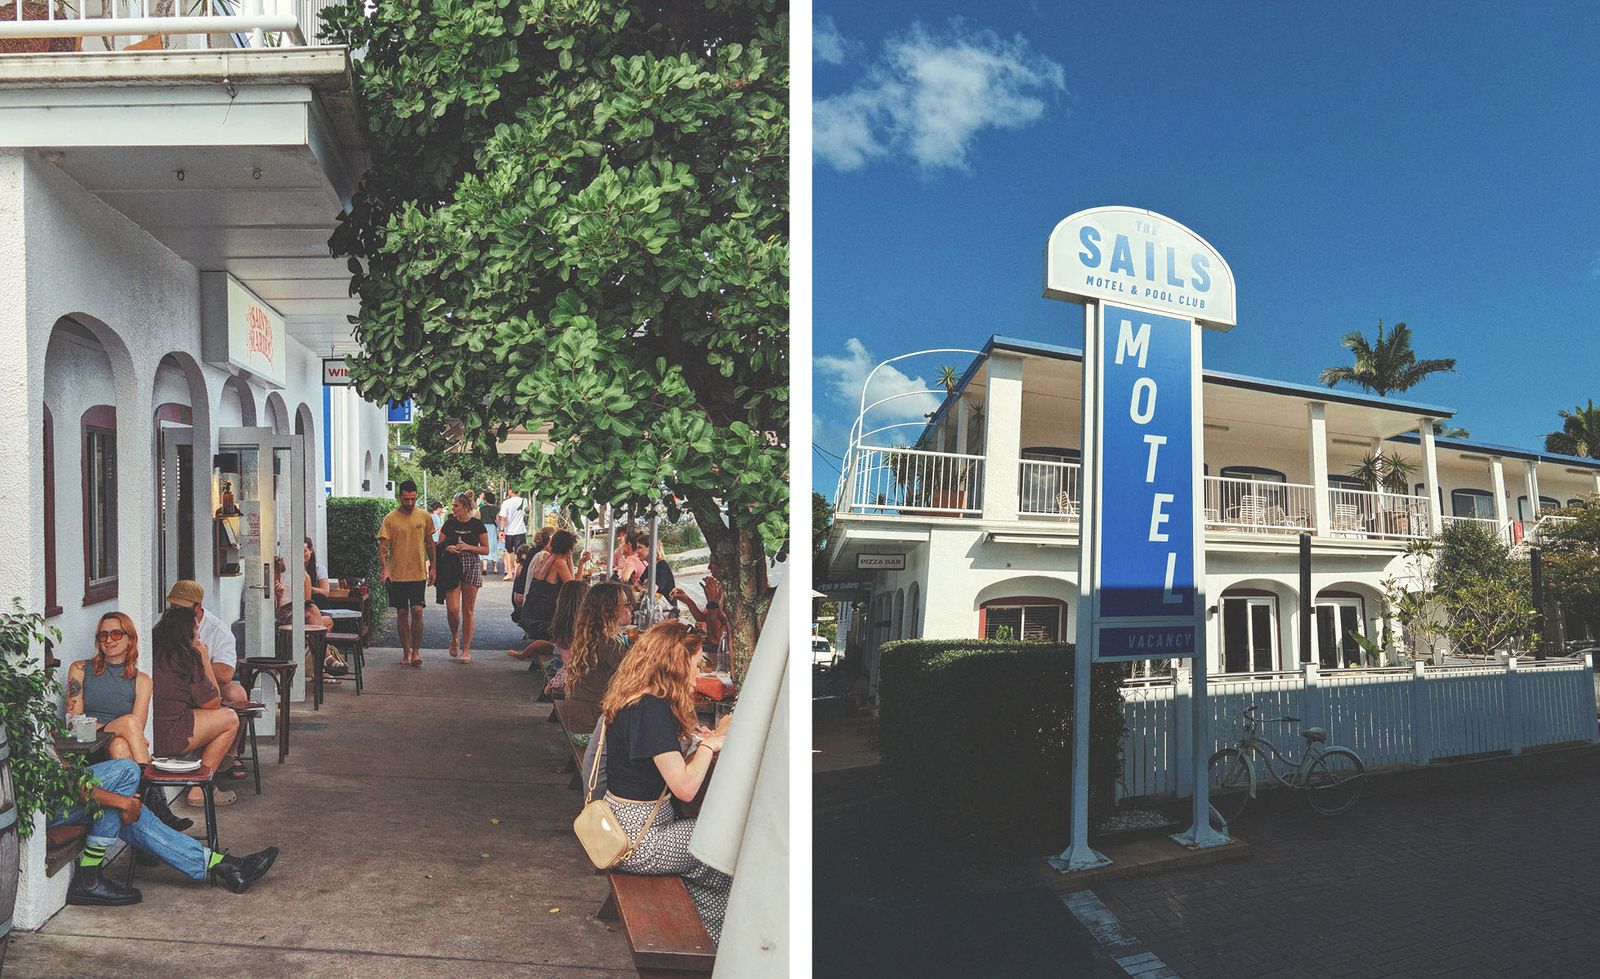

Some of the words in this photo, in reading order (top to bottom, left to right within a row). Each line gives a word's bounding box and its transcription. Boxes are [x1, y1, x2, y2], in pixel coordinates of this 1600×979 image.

[1135, 220, 1158, 236] THE
[1078, 225, 1211, 293] SAILS
[1086, 275, 1124, 292] MOTEL
[1130, 285, 1138, 296] &
[1145, 288, 1173, 302] POOL
[1178, 295, 1206, 309] CLUB
[1114, 319, 1183, 604] MOTEL
[1128, 633, 1192, 649] VACANCY
